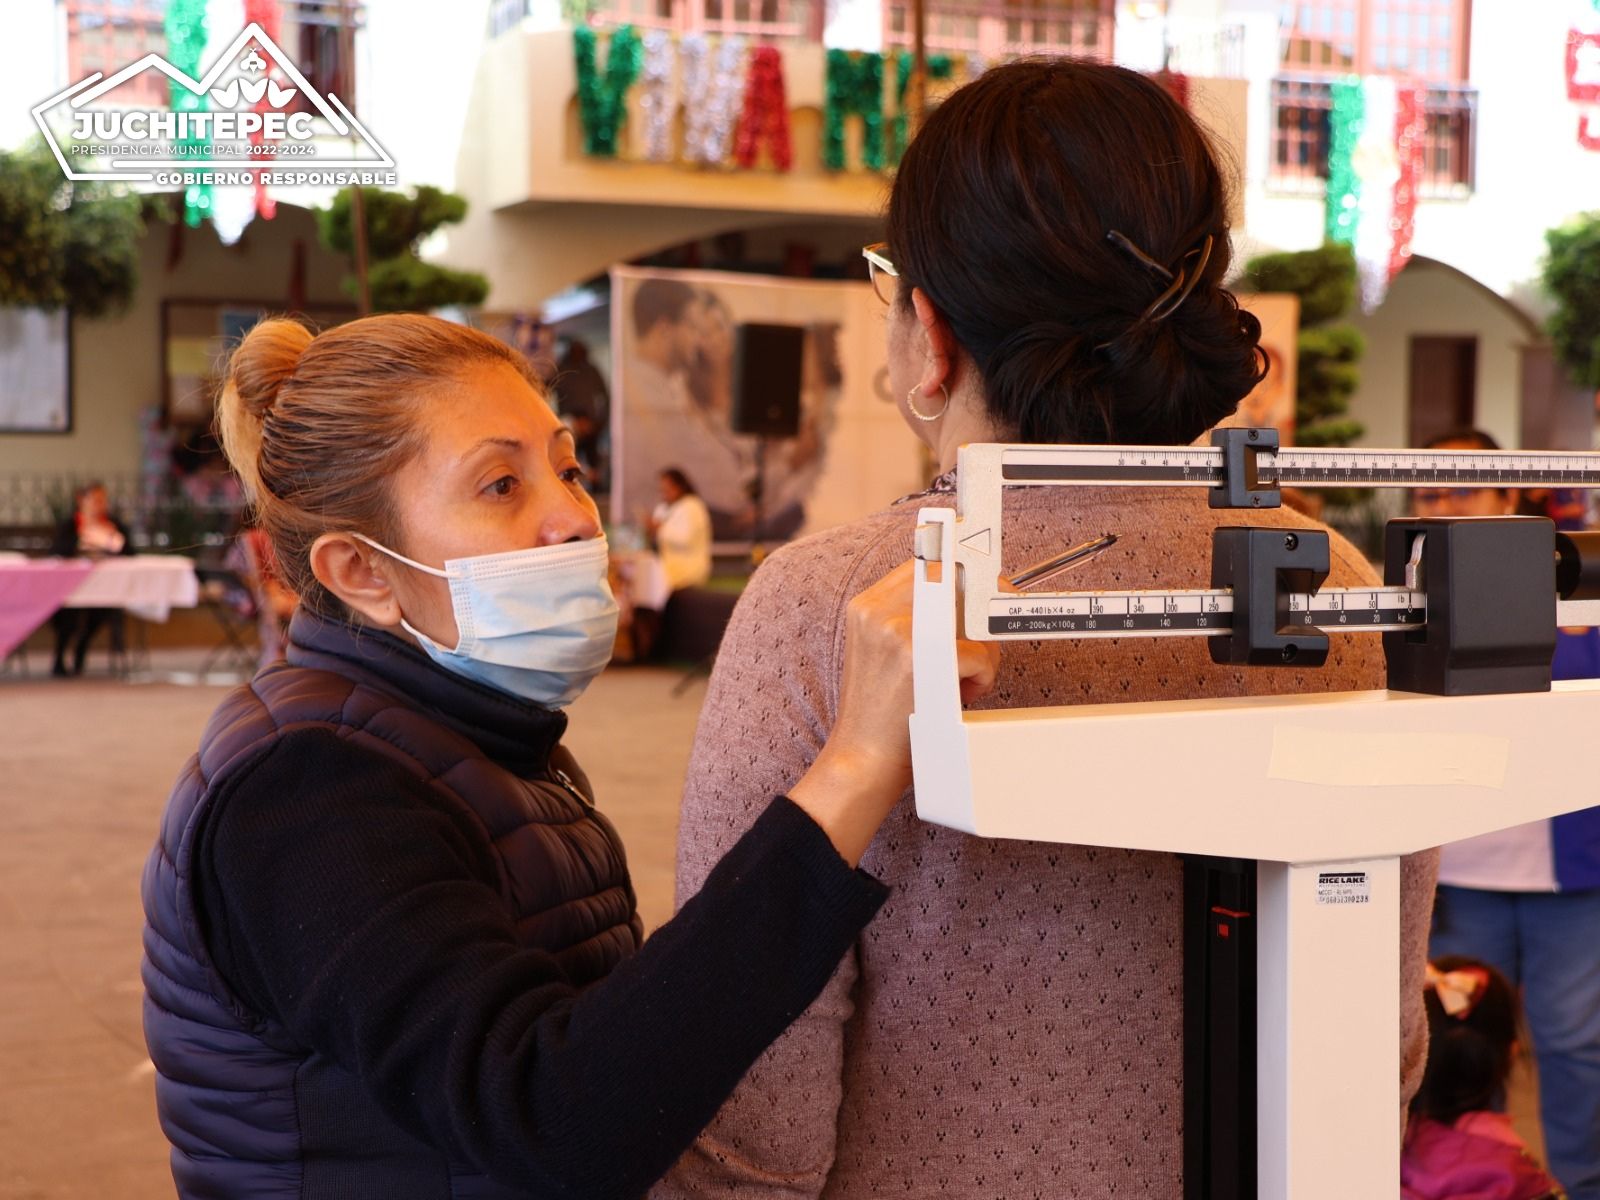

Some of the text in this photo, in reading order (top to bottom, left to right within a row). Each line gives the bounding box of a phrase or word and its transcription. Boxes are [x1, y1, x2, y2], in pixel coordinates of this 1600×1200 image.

[1008, 607, 1024, 615] CAP.
[1093, 605, 1104, 614] 390
[1134, 604, 1144, 613] 340
[1168, 604, 1178, 612] 300
[1208, 603, 1220, 612] 250
[1328, 601, 1338, 610] 100
[1368, 600, 1376, 608] 50
[1398, 594, 1405, 603] lb
[1408, 604, 1413, 614] 0
[1008, 621, 1023, 630] CAP.
[1086, 620, 1096, 629] 180
[1124, 619, 1134, 628] 160
[1160, 618, 1171, 627] 140
[1196, 618, 1207, 626] 120
[1340, 614, 1346, 624] 40
[1374, 614, 1380, 623] 20
[1398, 613, 1406, 622] kg
